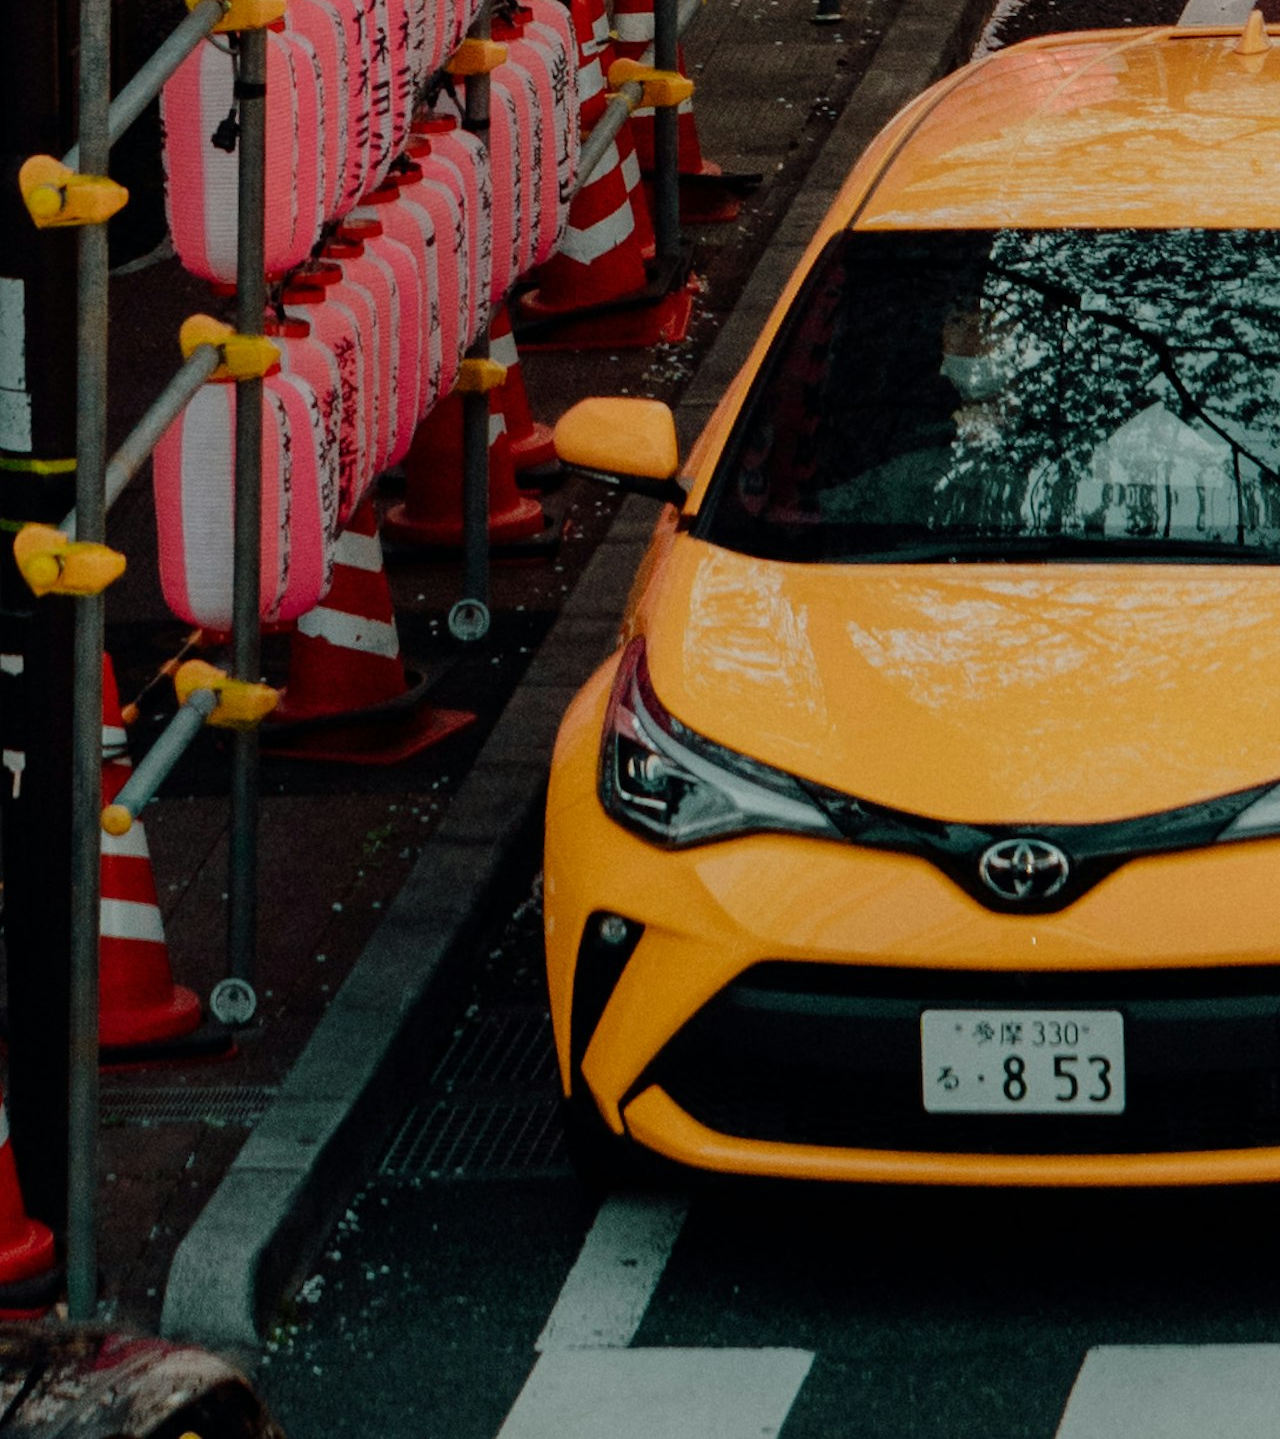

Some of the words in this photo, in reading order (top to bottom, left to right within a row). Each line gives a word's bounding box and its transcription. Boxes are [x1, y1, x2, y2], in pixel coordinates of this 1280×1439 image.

[973, 1021, 1024, 1047] 多摩
[1032, 1020, 1079, 1047] 330
[937, 1066, 960, 1092] る
